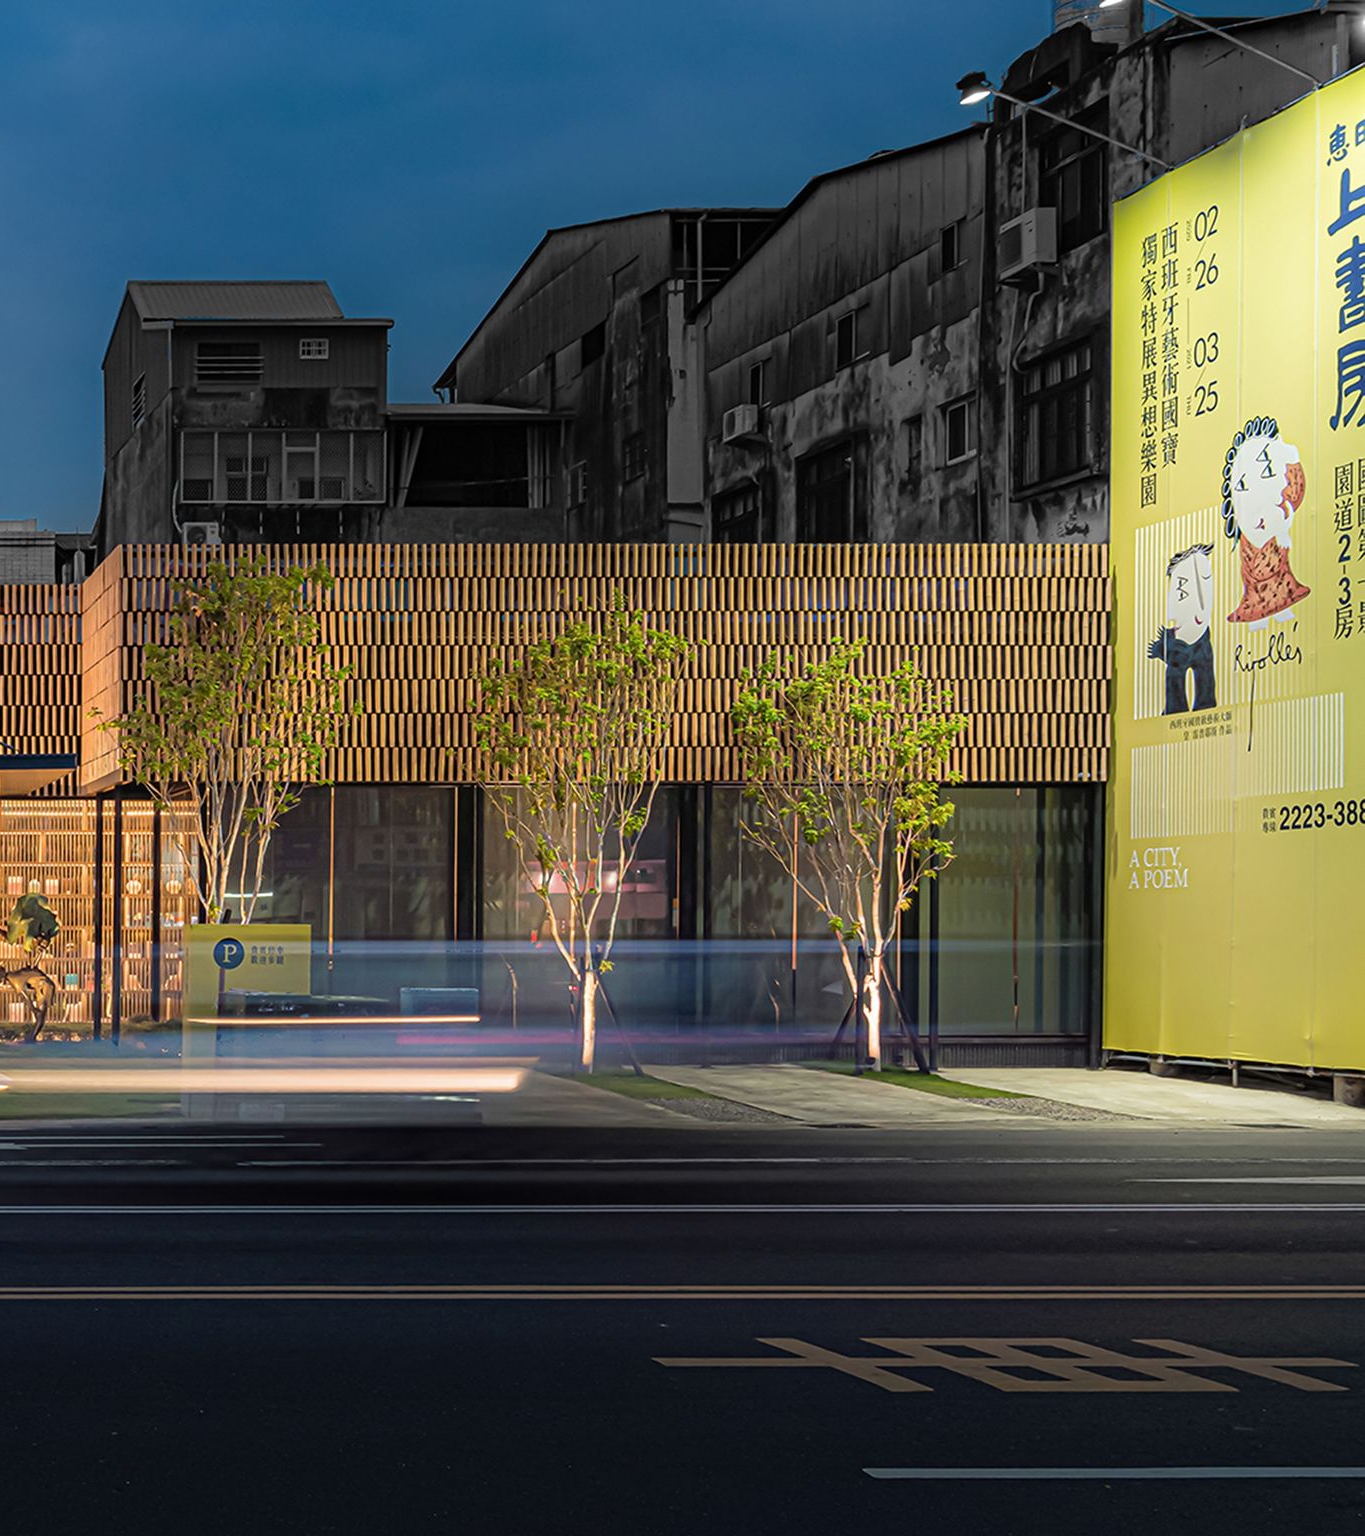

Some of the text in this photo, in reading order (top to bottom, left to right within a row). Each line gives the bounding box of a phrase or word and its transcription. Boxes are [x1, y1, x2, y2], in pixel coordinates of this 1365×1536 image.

[1194, 205, 1219, 241] 02
[1194, 252, 1219, 291] 26
[1161, 222, 1179, 469] 西班牙藝術國寶
[1193, 331, 1219, 368] 03
[1140, 233, 1157, 509] 獨家特展異想樂園
[1194, 380, 1219, 417] 25
[1334, 462, 1354, 640] 園道2-3房
[1129, 847, 1182, 869] A CITY,
[1129, 868, 1189, 889] A POEM
